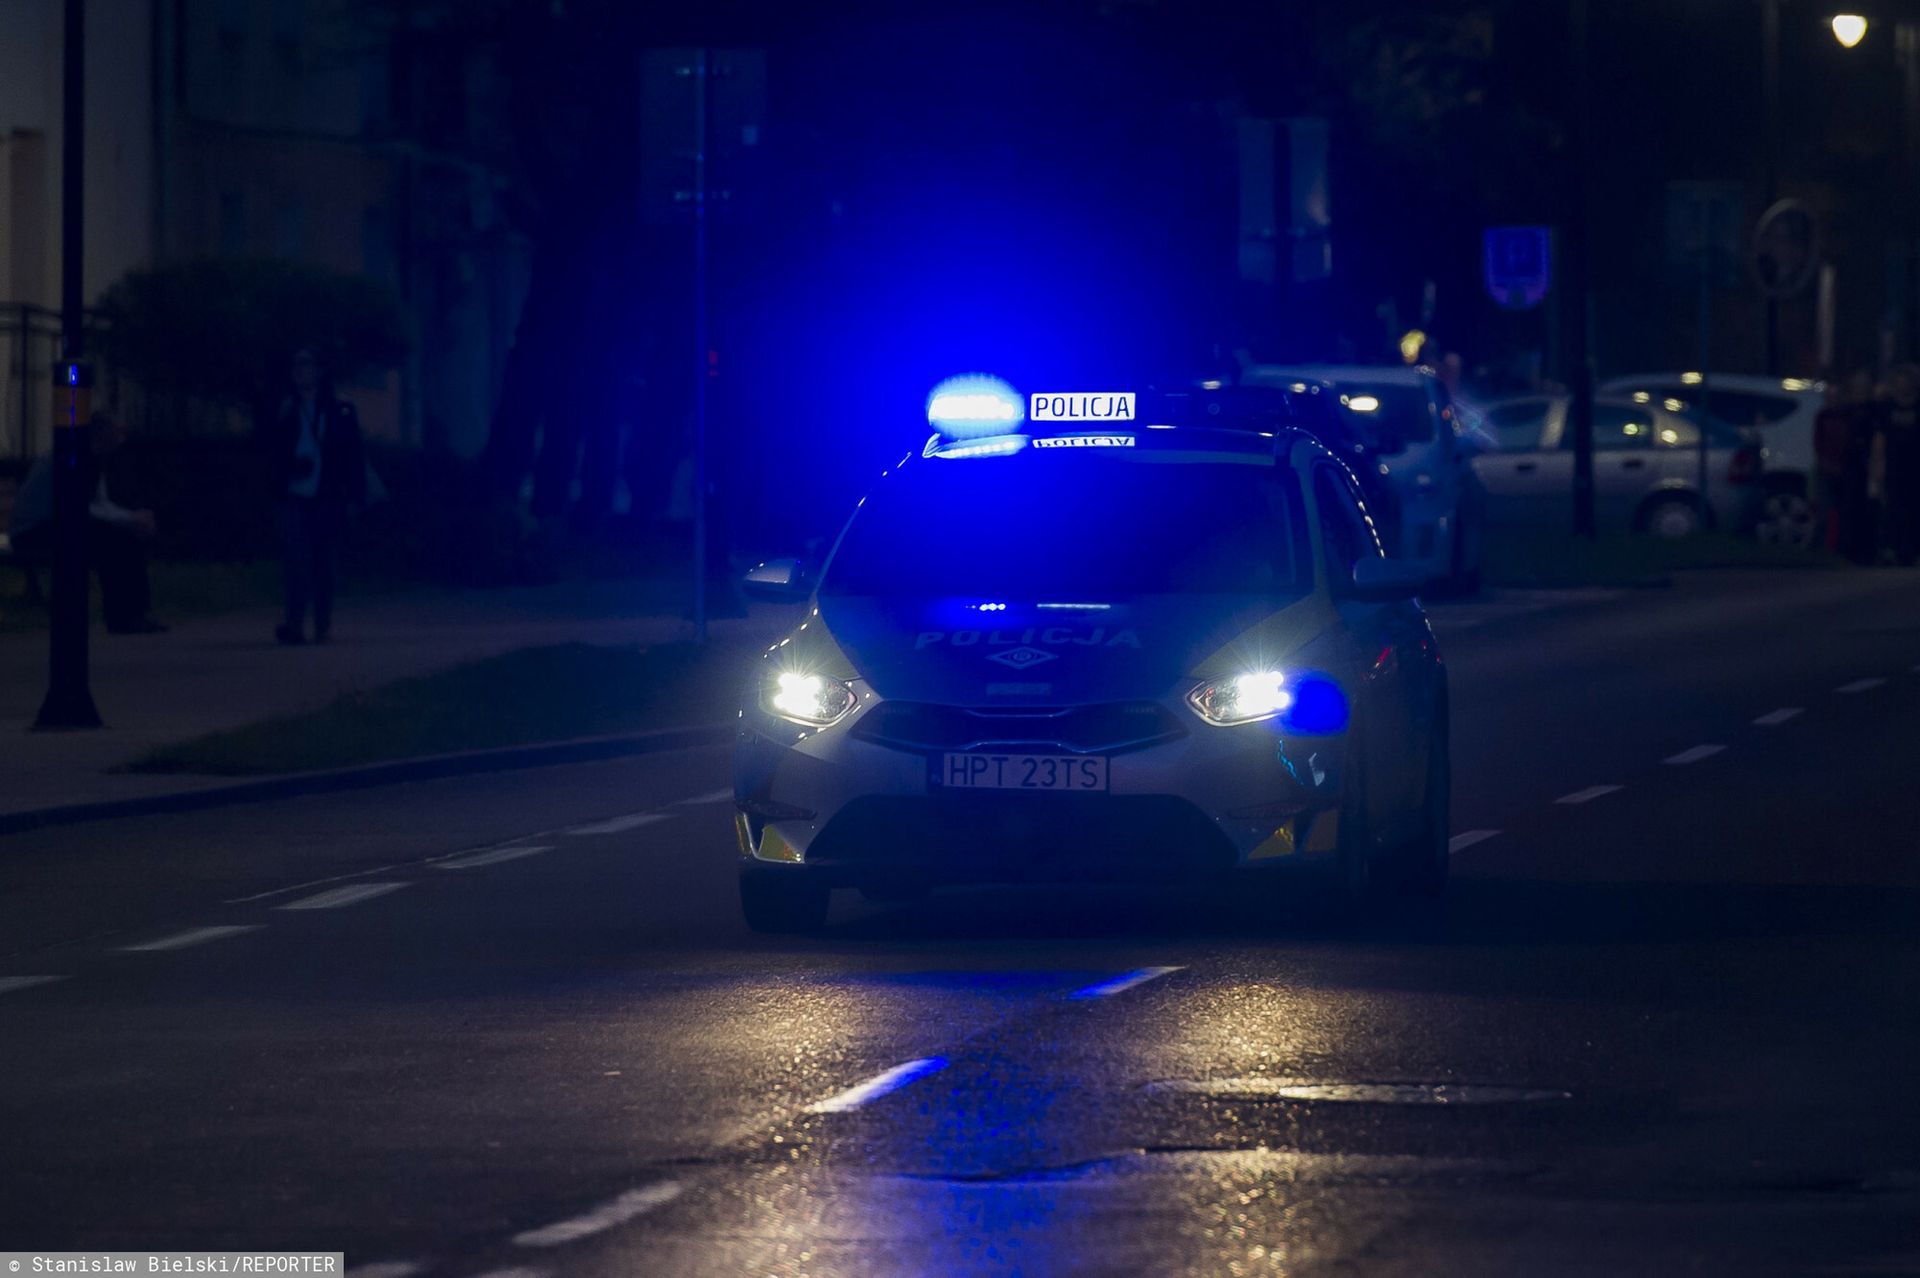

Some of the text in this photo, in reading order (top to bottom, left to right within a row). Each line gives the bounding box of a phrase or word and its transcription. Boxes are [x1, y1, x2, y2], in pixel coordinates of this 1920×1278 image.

[1035, 396, 1130, 418] POLICJA
[914, 627, 1143, 650] POLICJA
[949, 755, 1009, 786] HPT
[1020, 757, 1098, 788] 23TS
